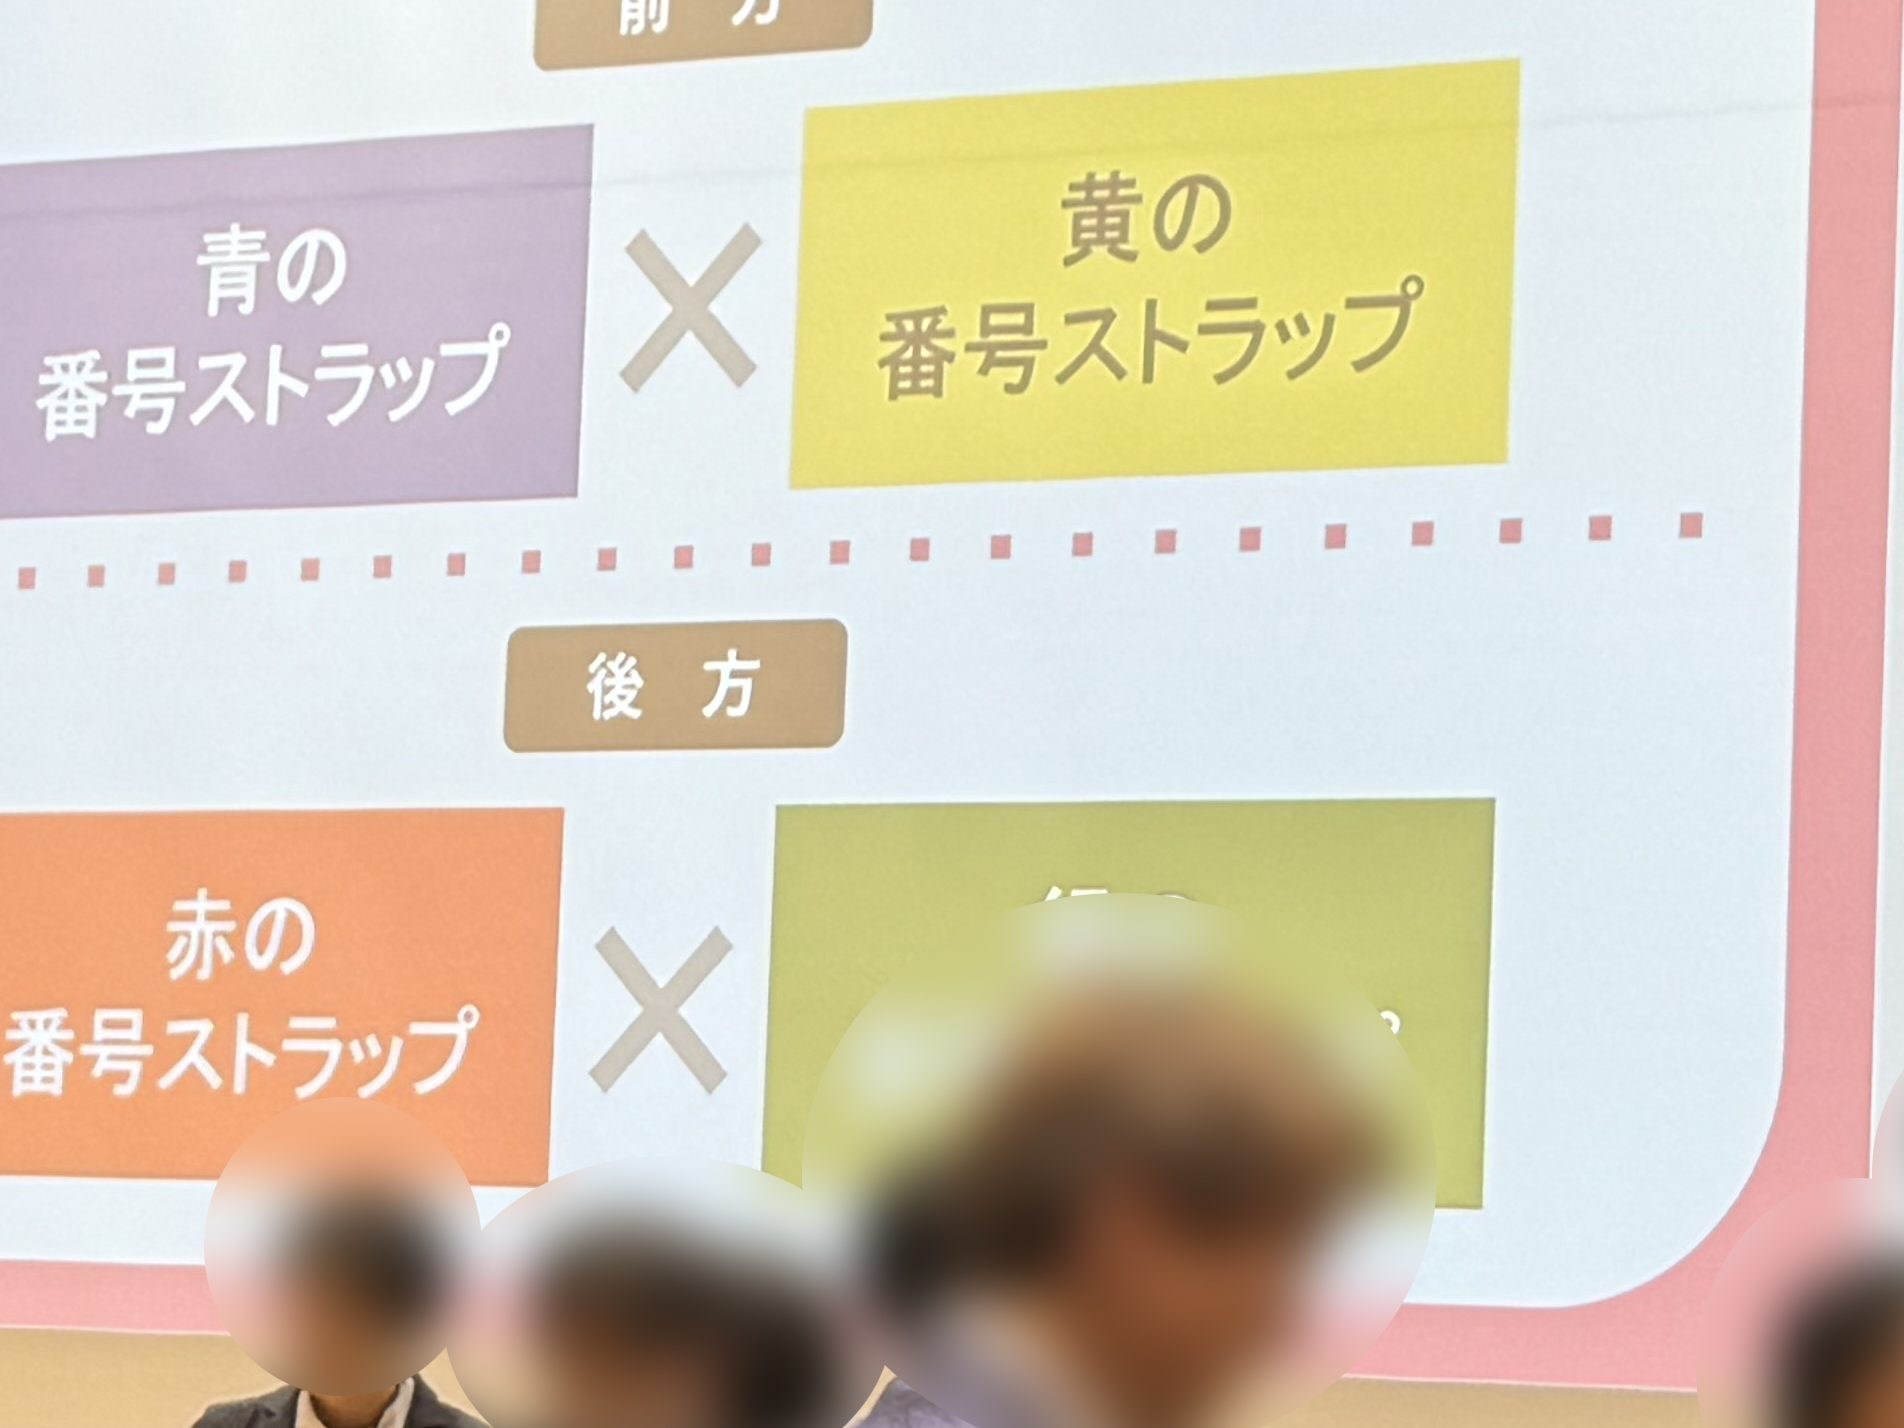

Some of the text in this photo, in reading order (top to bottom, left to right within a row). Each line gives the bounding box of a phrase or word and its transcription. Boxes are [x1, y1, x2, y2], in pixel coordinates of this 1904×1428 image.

[1061, 169, 1232, 268] 黄の
[196, 222, 348, 317] 青の
[35, 321, 512, 442] 番号ストラップ
[877, 273, 1425, 401] 番号ストラップ
[165, 887, 315, 981] 赤の
[3, 1004, 480, 1099] 番号ストラップ
